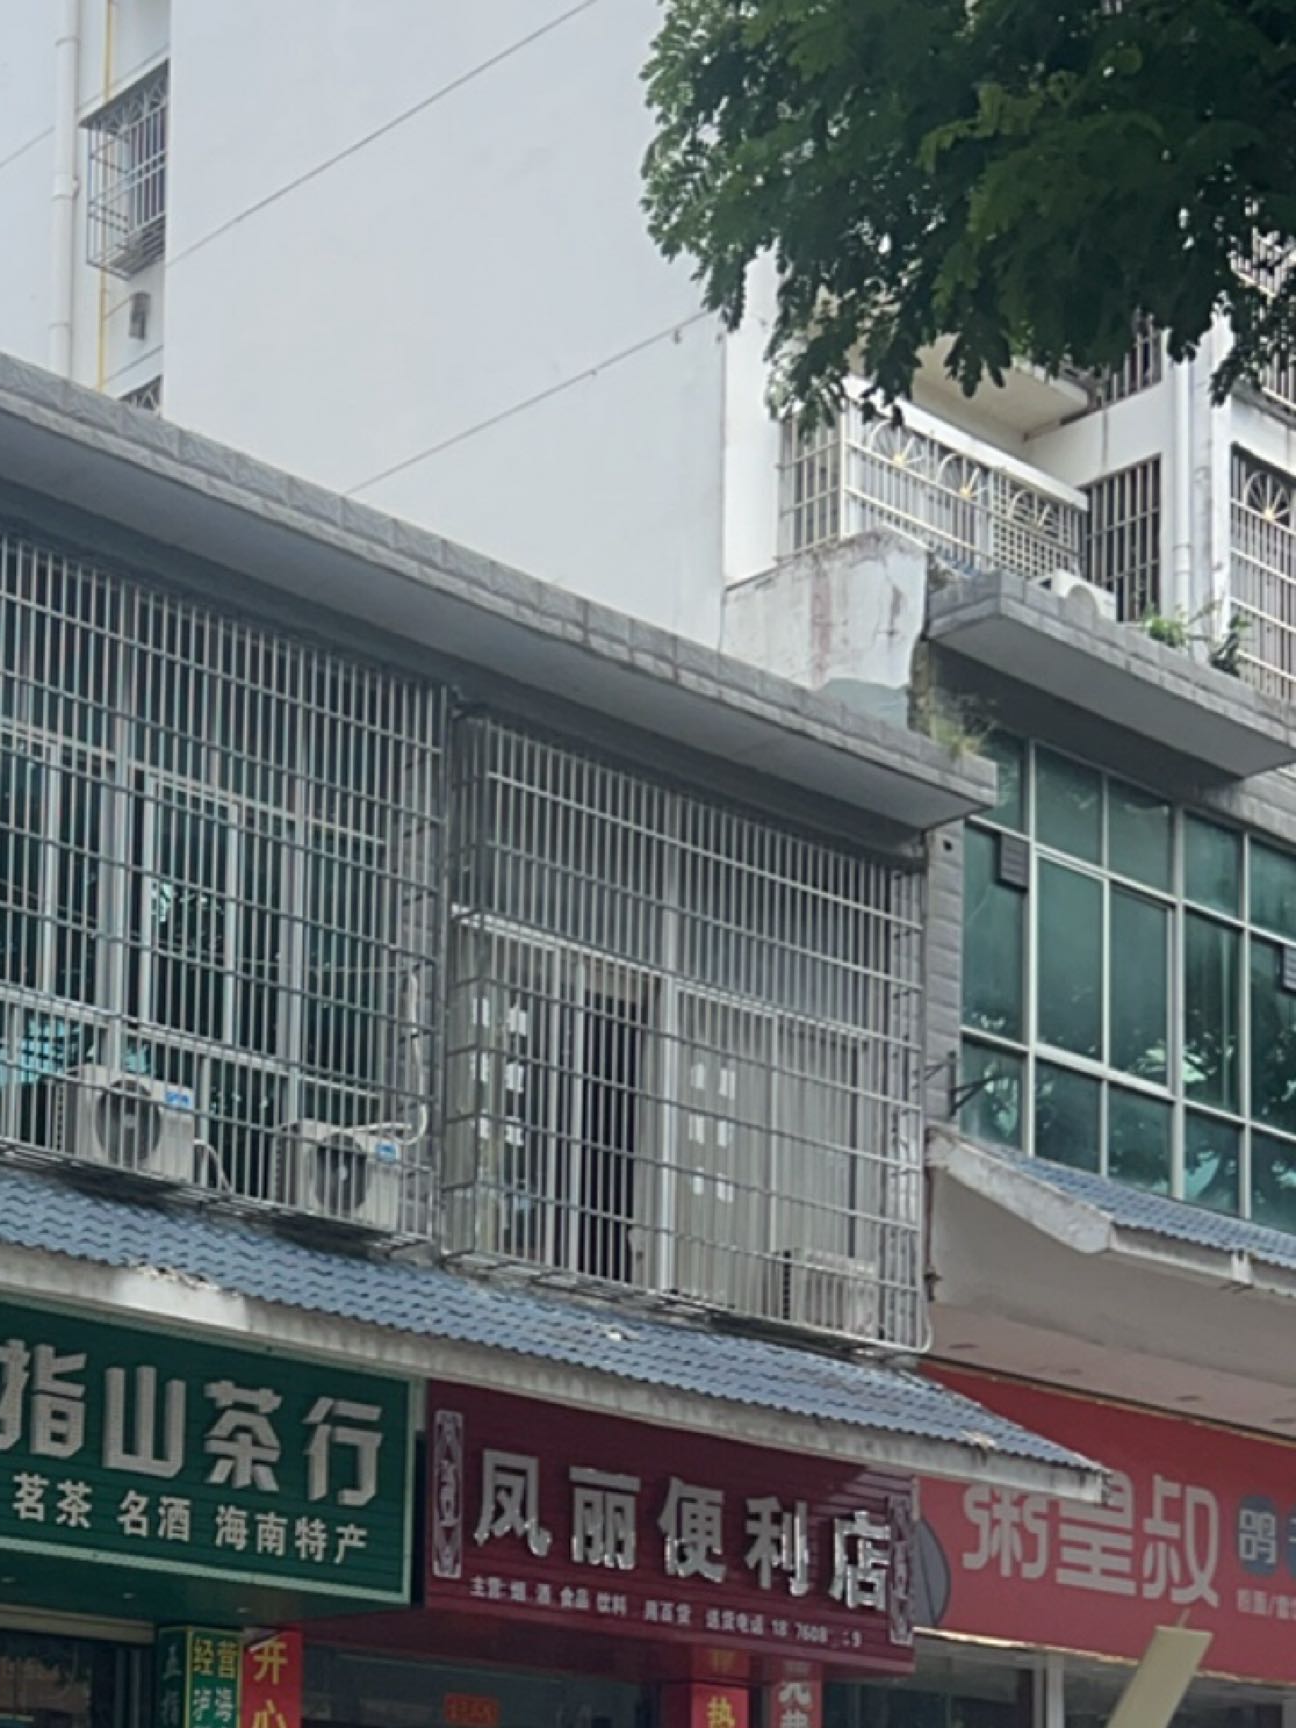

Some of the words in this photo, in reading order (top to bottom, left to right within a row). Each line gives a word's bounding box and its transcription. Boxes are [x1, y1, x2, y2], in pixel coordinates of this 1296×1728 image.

[13, 1472, 93, 1530] 茗茶
[117, 1490, 192, 1543] 名酒
[215, 1504, 368, 1565] 海南特产
[472, 1448, 893, 1611] 凤丽便利店
[961, 1470, 1220, 1609] 粥皇叔
